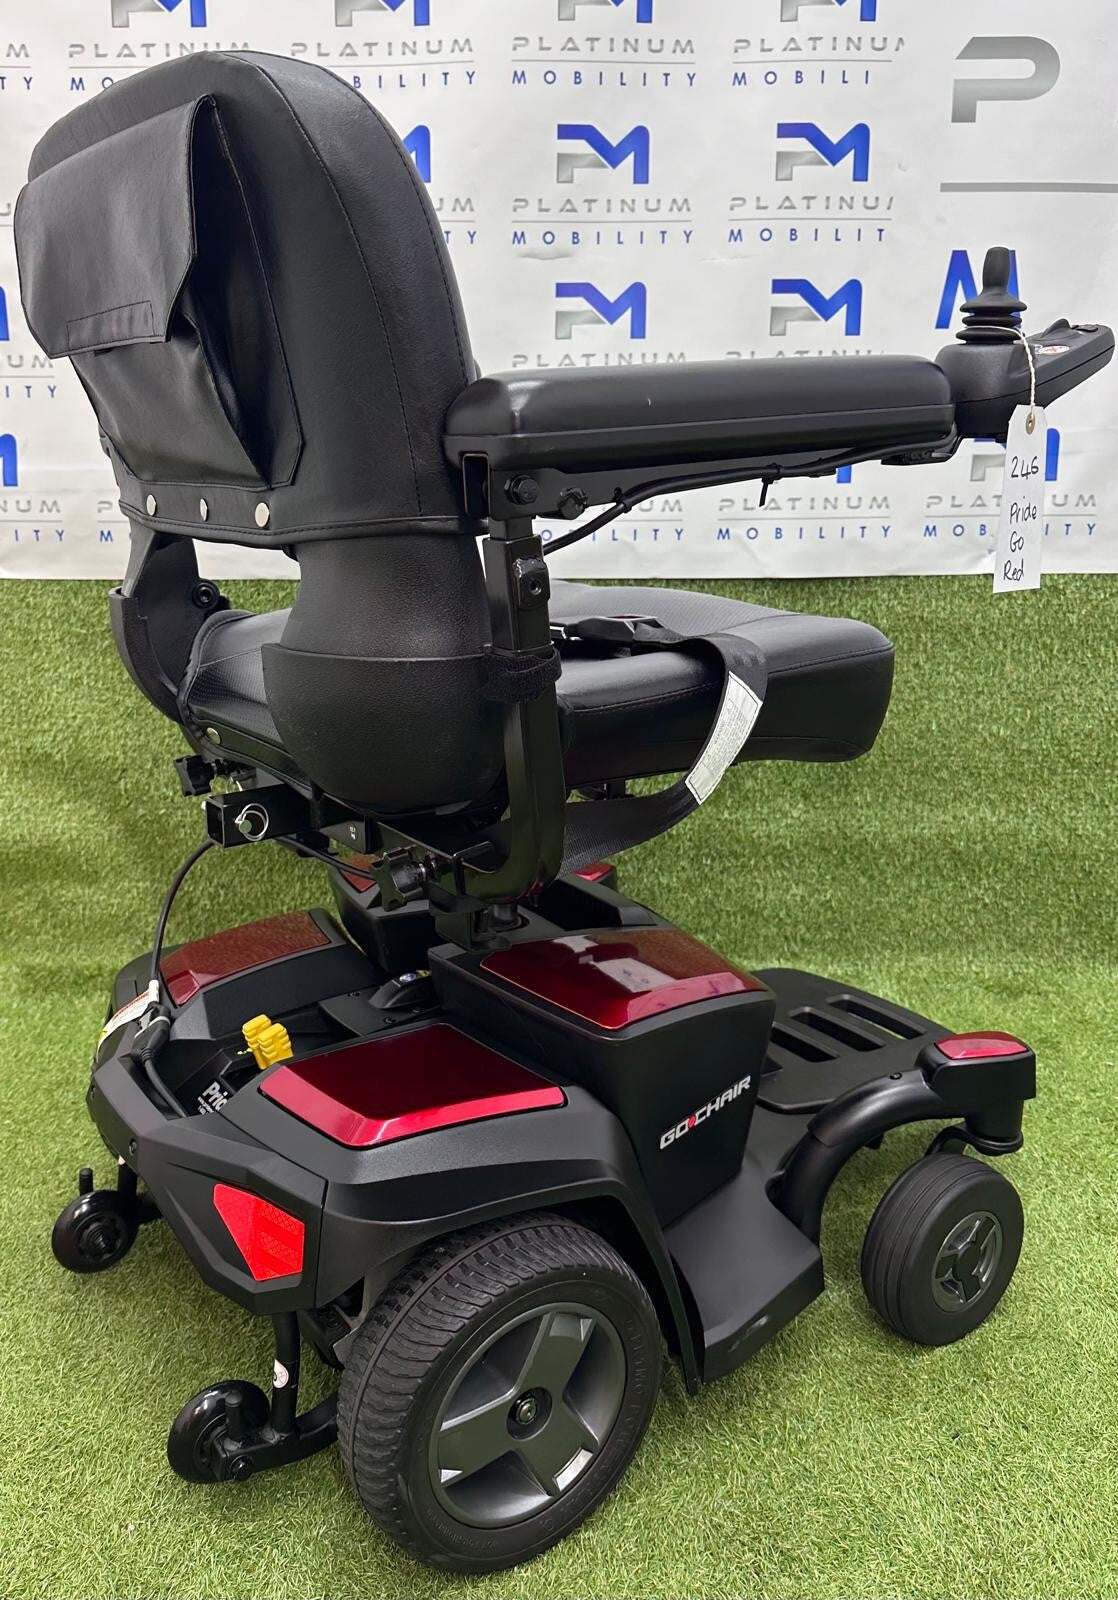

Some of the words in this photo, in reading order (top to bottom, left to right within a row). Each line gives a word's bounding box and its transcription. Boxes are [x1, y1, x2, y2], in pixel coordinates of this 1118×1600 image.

[290, 38, 474, 58] PLATINUM
[511, 36, 695, 54] PLATINUM
[352, 71, 476, 89] BILITY
[511, 69, 697, 87] MOBILITY
[511, 197, 692, 213] PLATINUM
[511, 229, 694, 246] MOBILITY
[1010, 455, 1040, 480] 246
[718, 496, 891, 512] PLATINUM
[925, 494, 1097, 509] PLATUM
[1008, 501, 1038, 526] Pride
[716, 526, 891, 541] MOBILITY
[923, 523, 1096, 538] MOBITY
[1008, 531, 1025, 553] Go
[1003, 558, 1024, 582] Red
